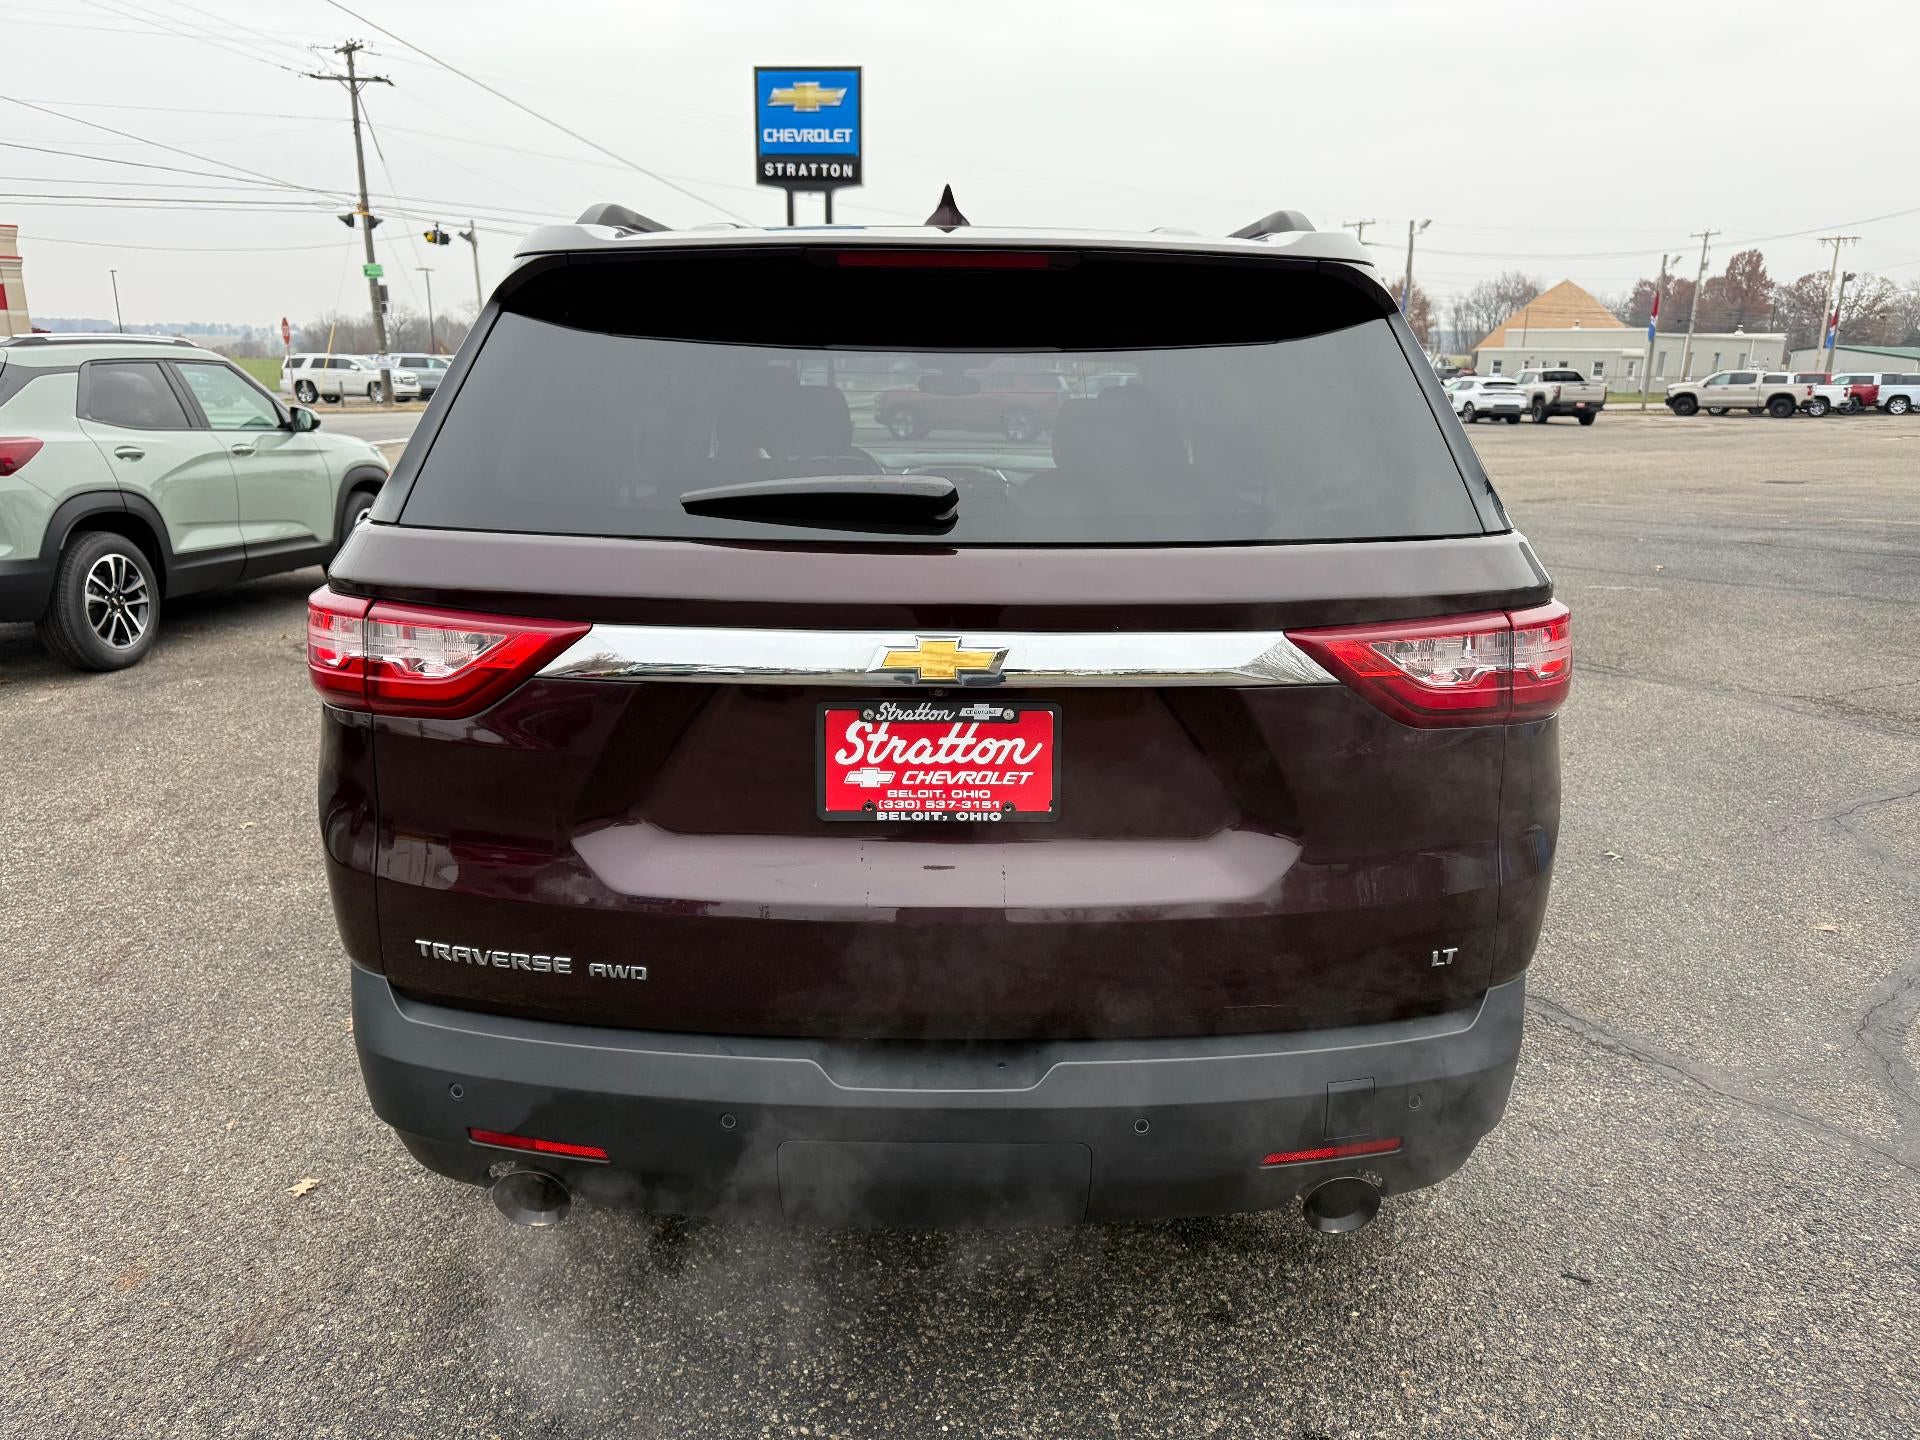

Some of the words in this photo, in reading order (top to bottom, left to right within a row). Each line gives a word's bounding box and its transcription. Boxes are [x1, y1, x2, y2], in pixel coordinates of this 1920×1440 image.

[763, 128, 853, 143] CHEVROLET
[764, 162, 853, 178] STRATTON
[875, 702, 955, 721] Stratton
[834, 719, 1043, 765] Stratton
[901, 770, 1034, 785] CHEVROLET
[887, 789, 946, 799] BELOIT,
[951, 789, 991, 799] OHIO
[878, 800, 921, 810] (330)
[925, 800, 1000, 810] 537-3151
[876, 811, 948, 822] BELOIT,
[955, 811, 1002, 822] OHIO
[415, 939, 572, 975] TRAVERSE
[588, 962, 648, 981] AWD
[1431, 947, 1459, 968] LT
